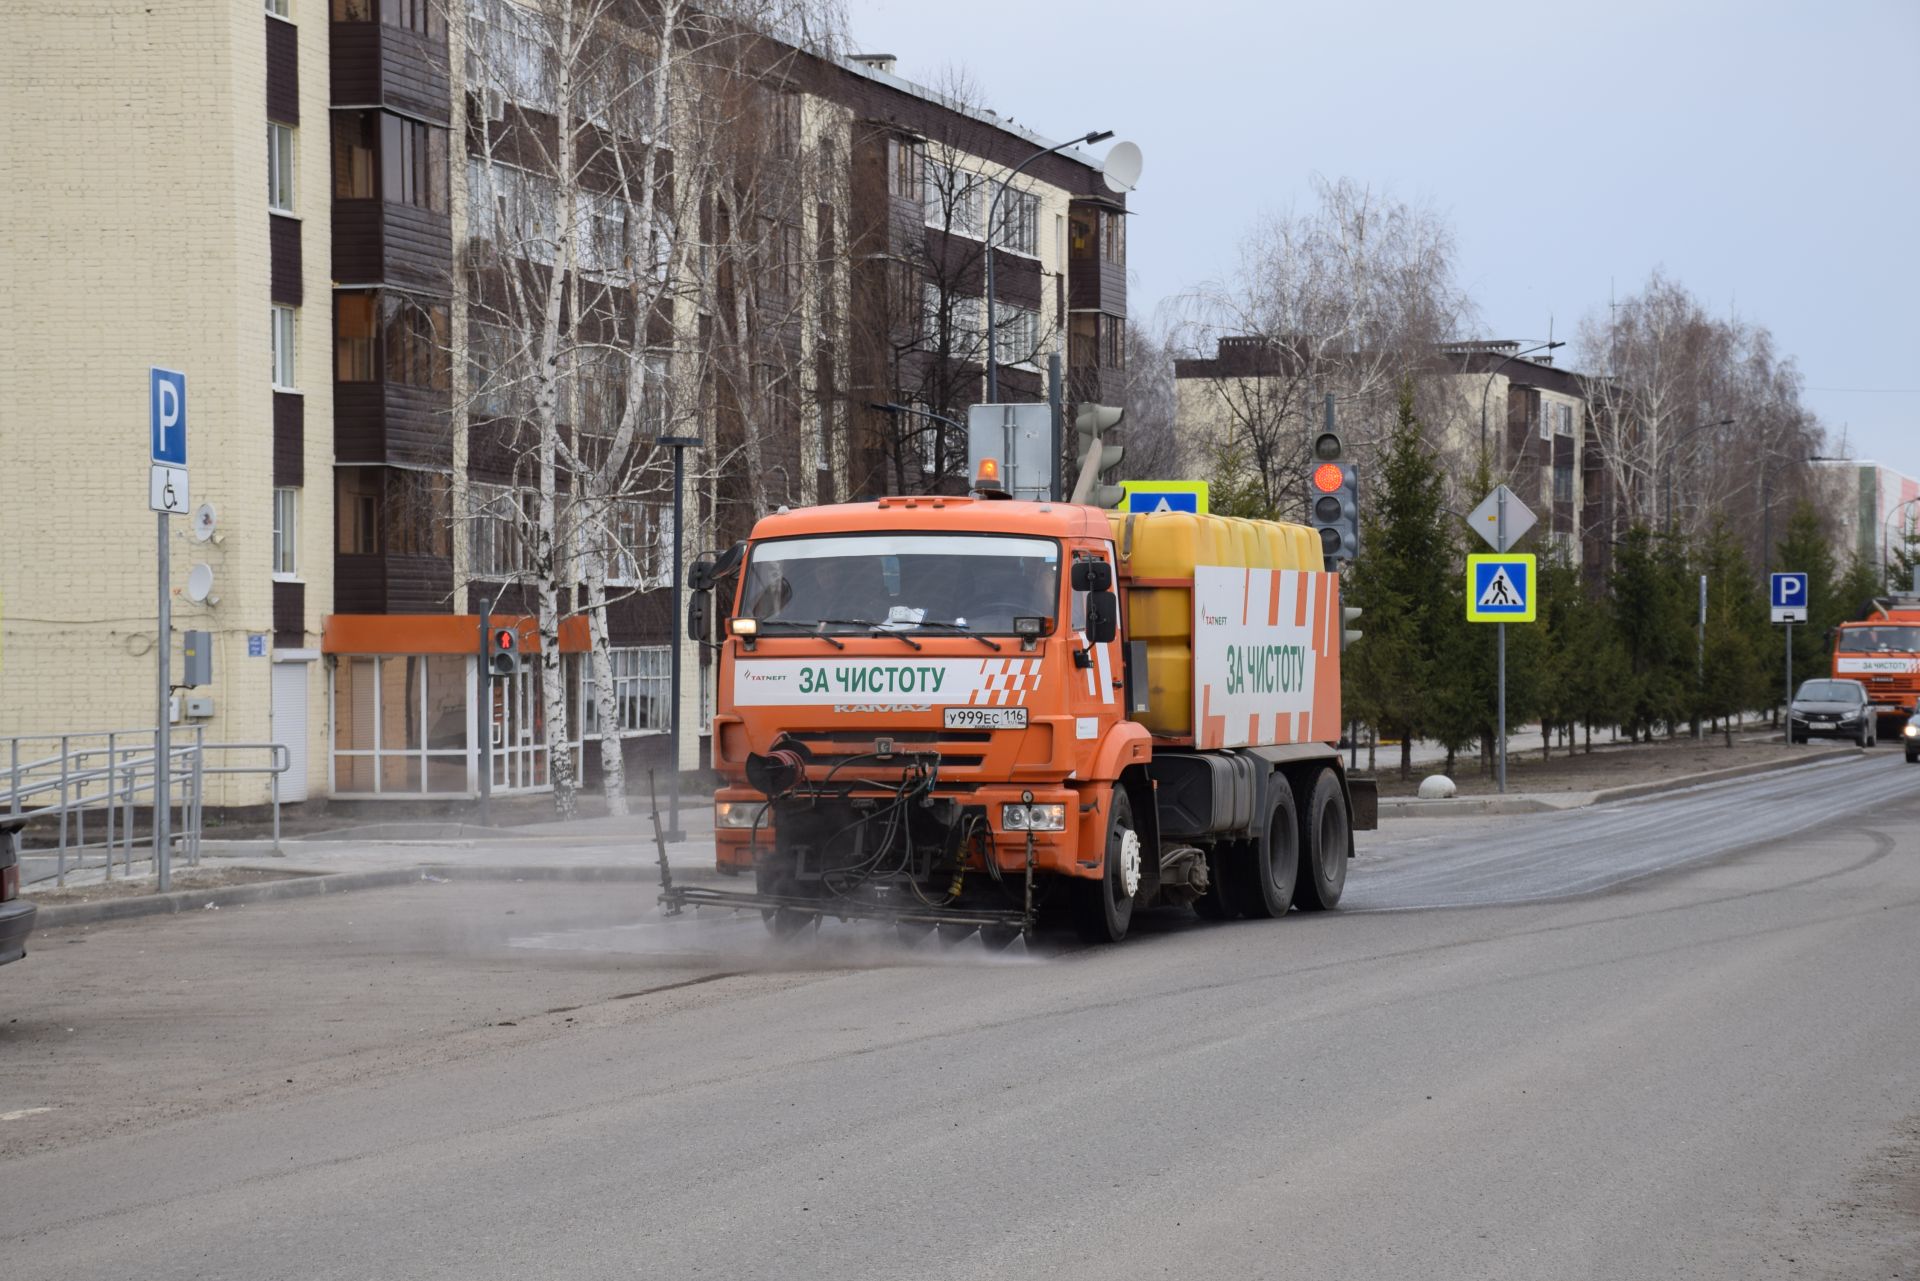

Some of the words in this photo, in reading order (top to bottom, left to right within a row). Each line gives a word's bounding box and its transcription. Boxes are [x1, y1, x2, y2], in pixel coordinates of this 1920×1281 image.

[159, 379, 179, 451] P
[1781, 577, 1801, 604] P
[1206, 616, 1227, 625] TATNEFT
[799, 667, 829, 693] ЗА
[836, 667, 946, 693] ЧИСТОТУ
[1226, 645, 1244, 695] ЗА
[1248, 645, 1305, 694] ЧИСТОТУ
